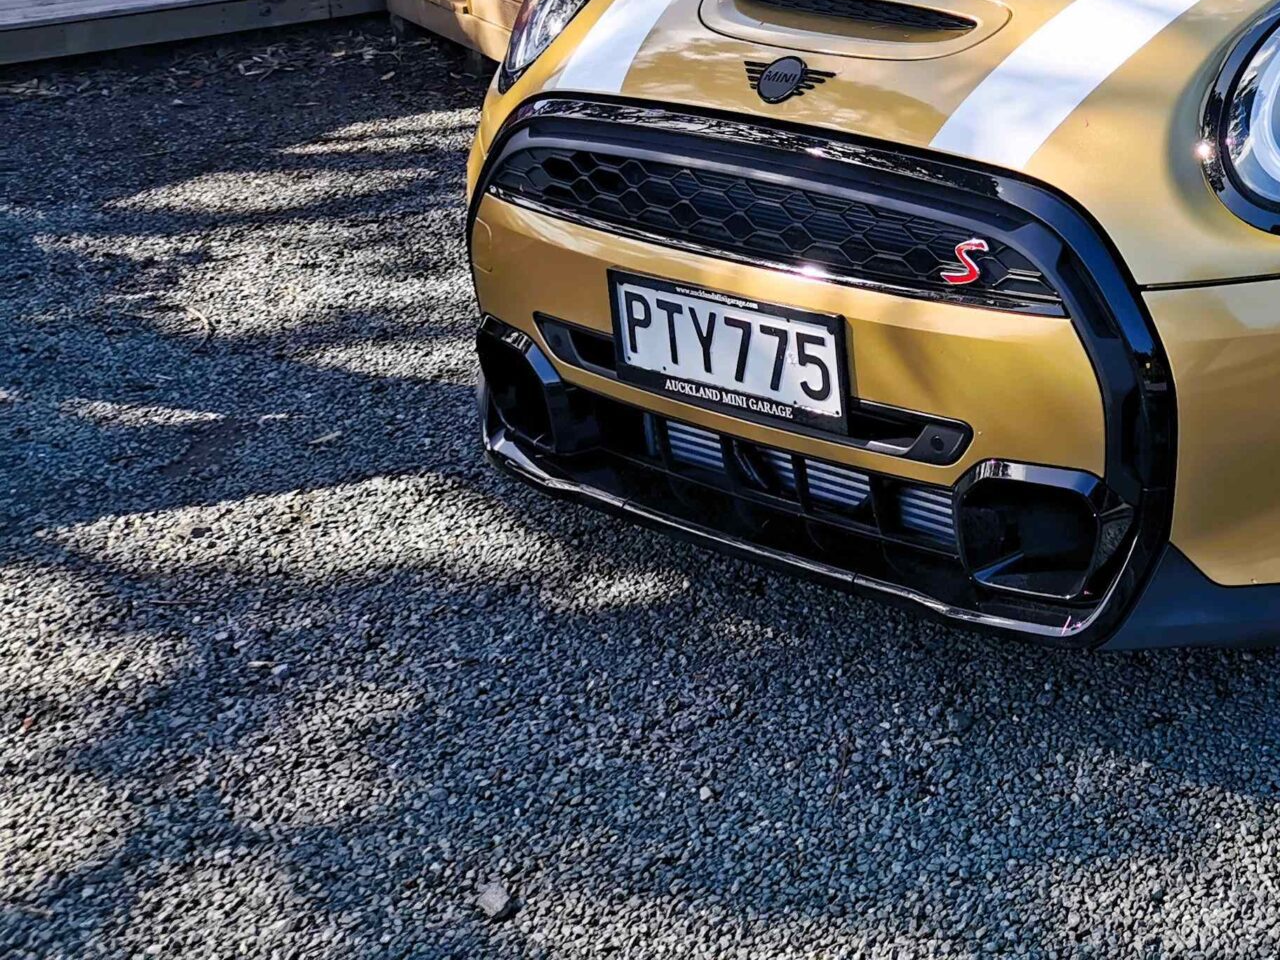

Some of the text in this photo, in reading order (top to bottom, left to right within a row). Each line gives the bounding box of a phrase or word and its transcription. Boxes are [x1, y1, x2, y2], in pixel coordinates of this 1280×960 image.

[764, 70, 798, 84] MINI
[940, 238, 989, 285] S
[624, 290, 832, 402] PTY775
[665, 378, 794, 419] AUCKLAND MINI GARAGE
